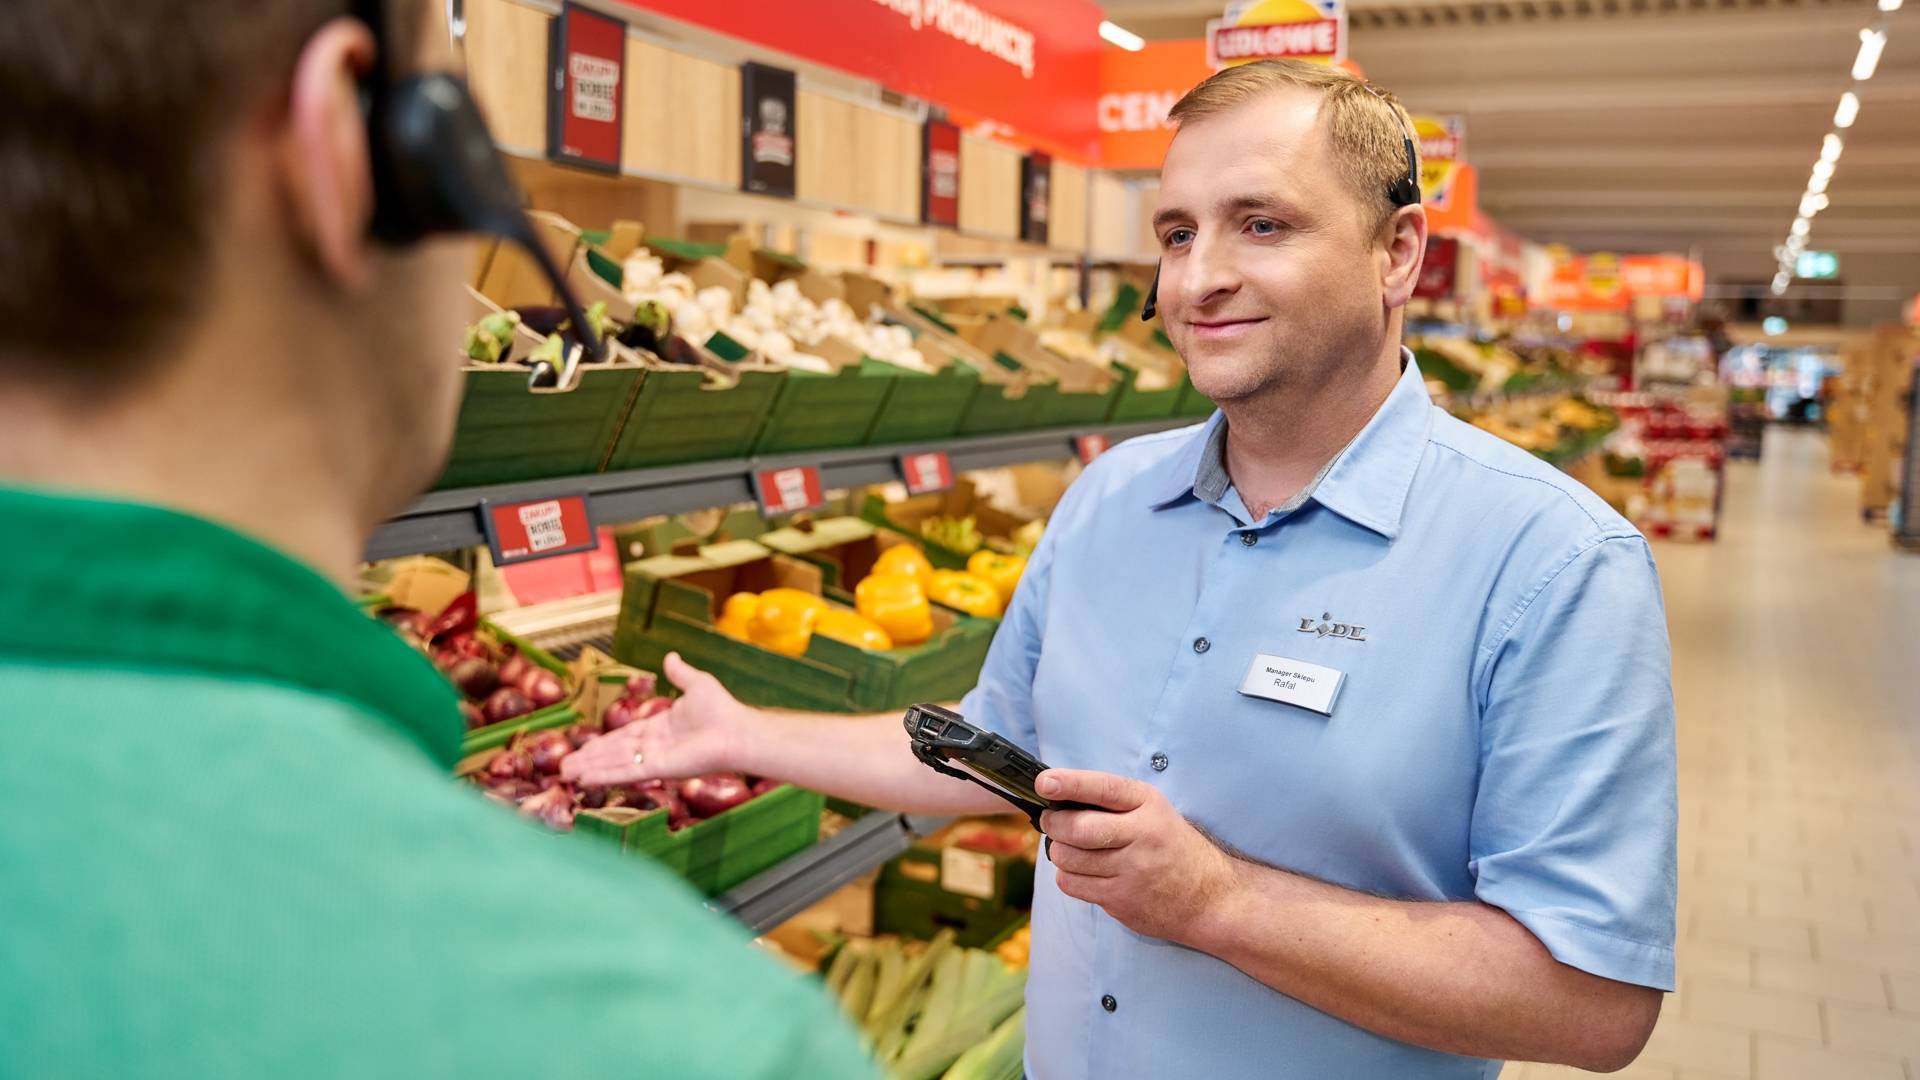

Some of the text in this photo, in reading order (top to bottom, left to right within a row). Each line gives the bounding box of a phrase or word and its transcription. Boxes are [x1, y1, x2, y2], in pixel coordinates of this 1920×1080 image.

[1296, 611, 1366, 641] LIDL
[1265, 666, 1315, 683] Manager Sklepu
